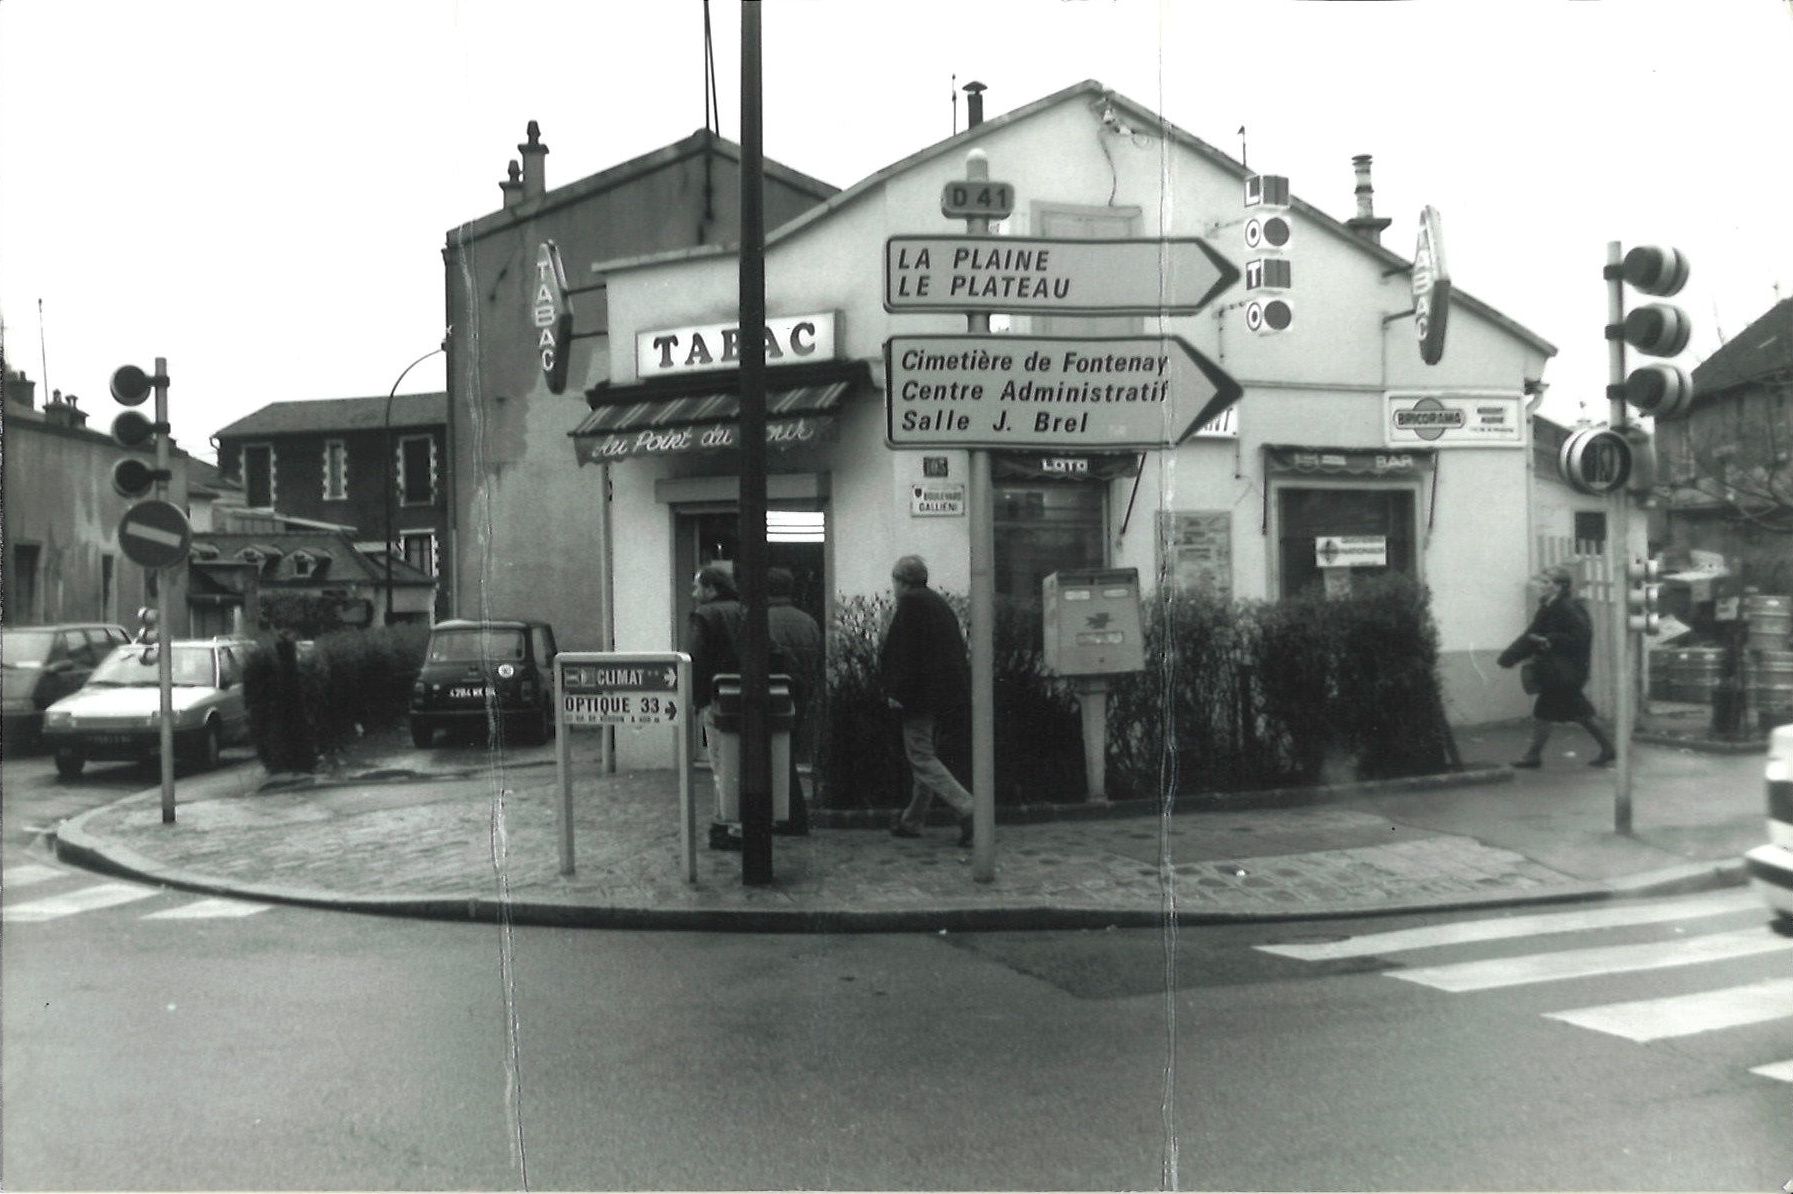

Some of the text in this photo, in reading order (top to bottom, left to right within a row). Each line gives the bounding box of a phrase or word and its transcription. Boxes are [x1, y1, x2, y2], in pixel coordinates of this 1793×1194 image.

[953, 187, 1006, 209] D 41
[899, 247, 1050, 272] LA PLAINE
[899, 276, 1071, 299] LE PLATEAU
[535, 260, 556, 371] TABAC
[902, 349, 1169, 377] Cimetière de Fontenay
[902, 380, 1169, 403] Centre Administratif
[902, 409, 1089, 433] Salle J. Brel
[632, 426, 693, 453] Point
[701, 424, 733, 448] du
[1041, 458, 1088, 473] LOTO
[1375, 454, 1413, 469] BAR
[597, 668, 644, 685] CLIMAT
[565, 695, 660, 715] OPTIQUE 33
